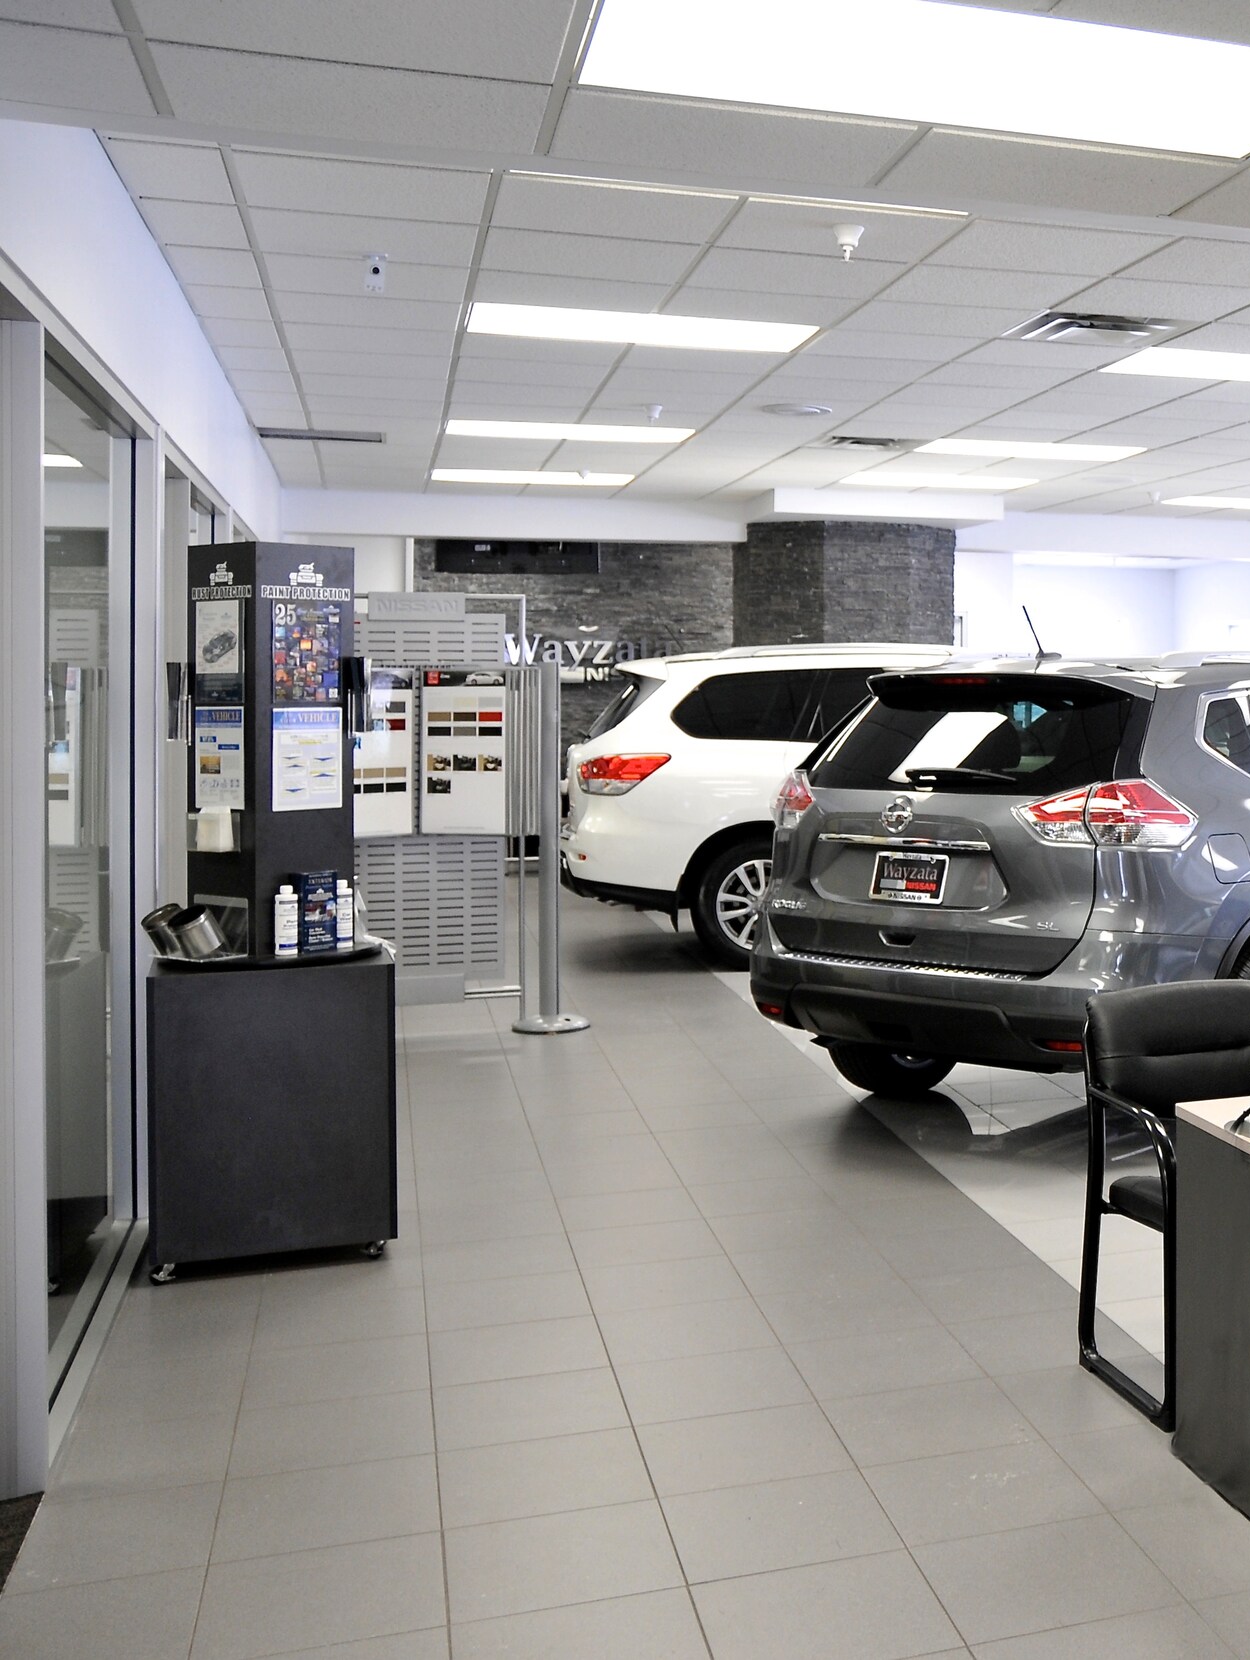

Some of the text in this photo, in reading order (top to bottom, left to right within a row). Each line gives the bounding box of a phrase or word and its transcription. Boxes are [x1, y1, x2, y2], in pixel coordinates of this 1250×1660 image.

[192, 585, 252, 599] RUST PROTECTION
[261, 585, 350, 601] PAINT PROTECTION
[377, 600, 457, 613] NISSAN
[275, 603, 296, 626] 25
[298, 712, 337, 723] VEHICLE
[883, 861, 938, 882] Wayzata
[905, 881, 937, 891] NISSAN
[1036, 921, 1060, 931] SL
